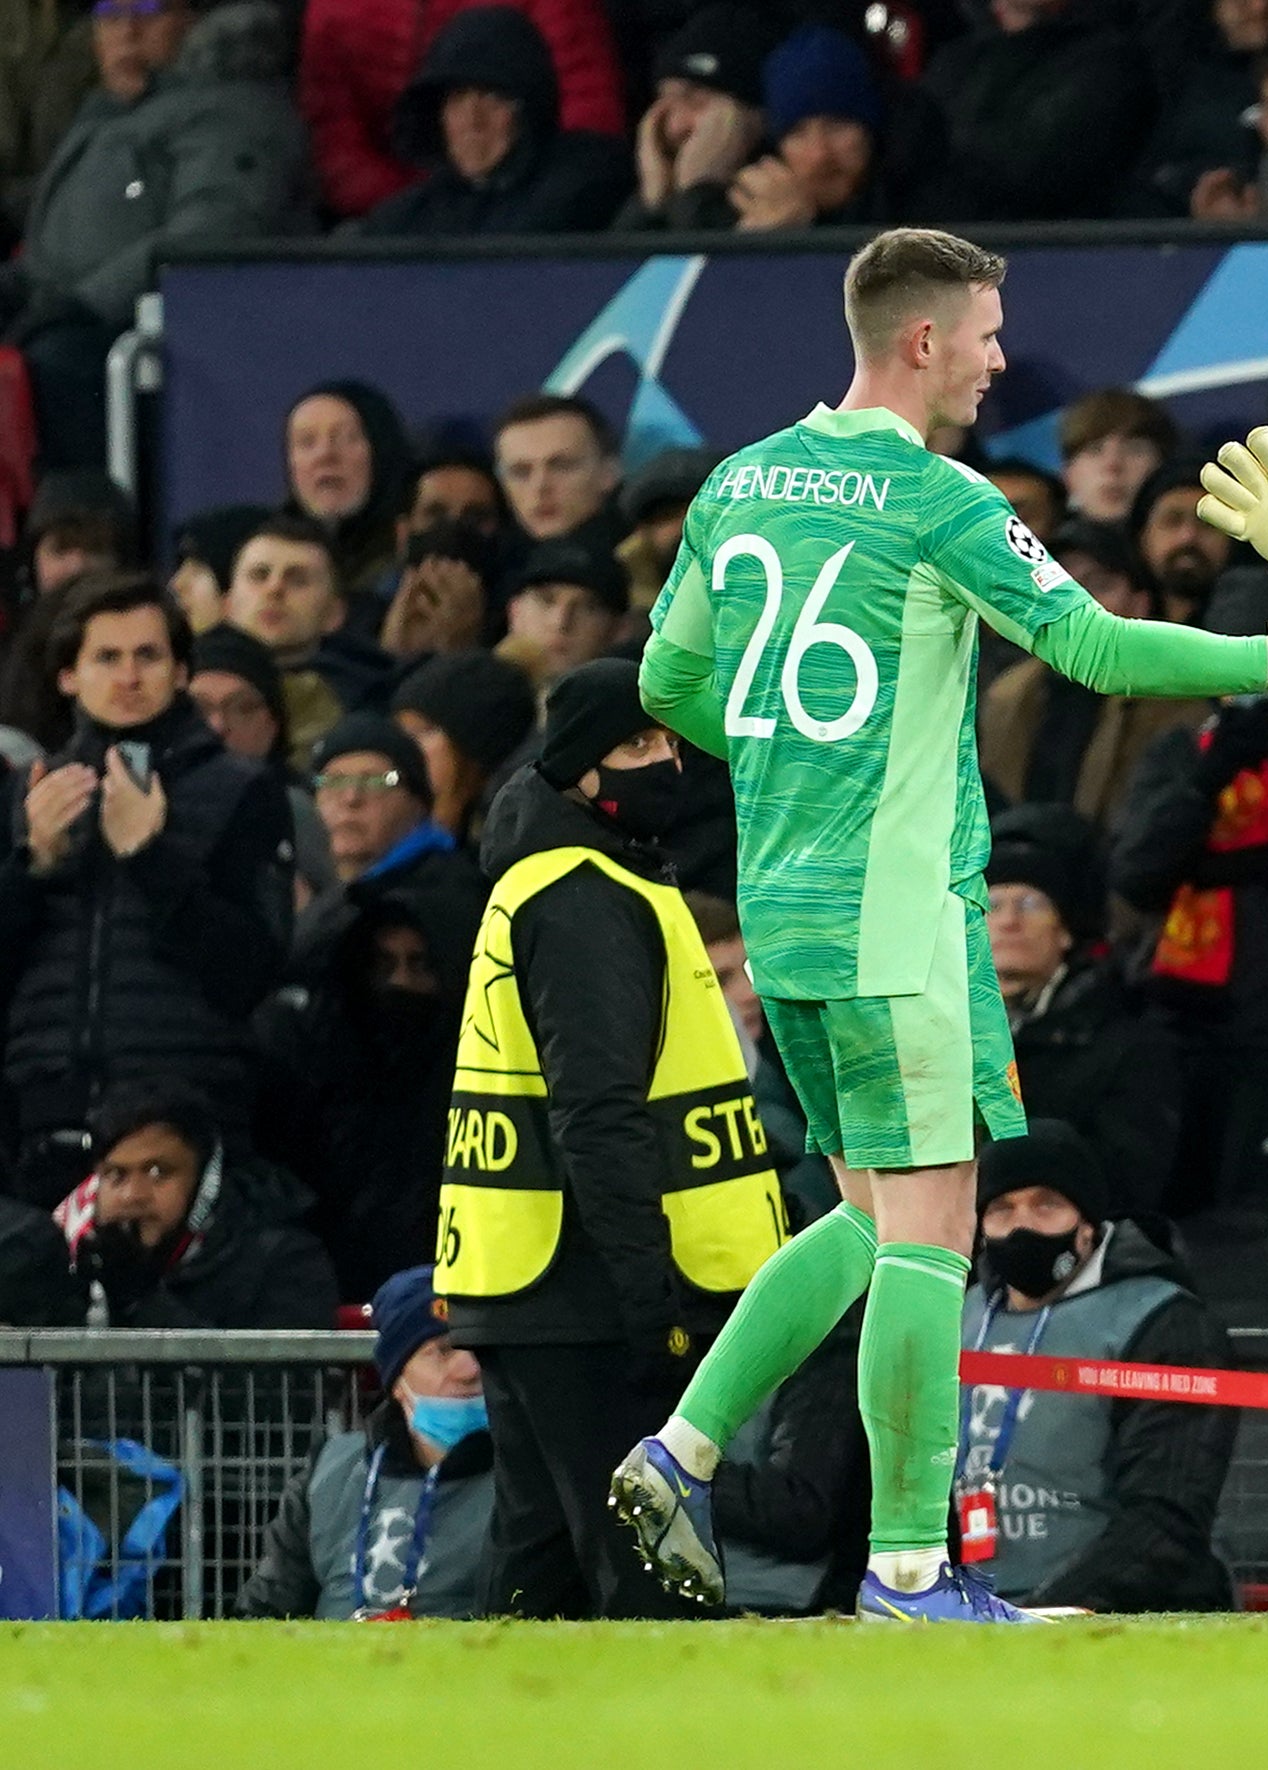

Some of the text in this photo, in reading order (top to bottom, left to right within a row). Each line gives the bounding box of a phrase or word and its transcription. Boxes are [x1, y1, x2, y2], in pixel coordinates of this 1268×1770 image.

[717, 465, 891, 512] HENDERSON
[711, 533, 879, 742] 26
[1078, 1366, 1217, 1395] YOU ARE LEAVING A RED ZONE
